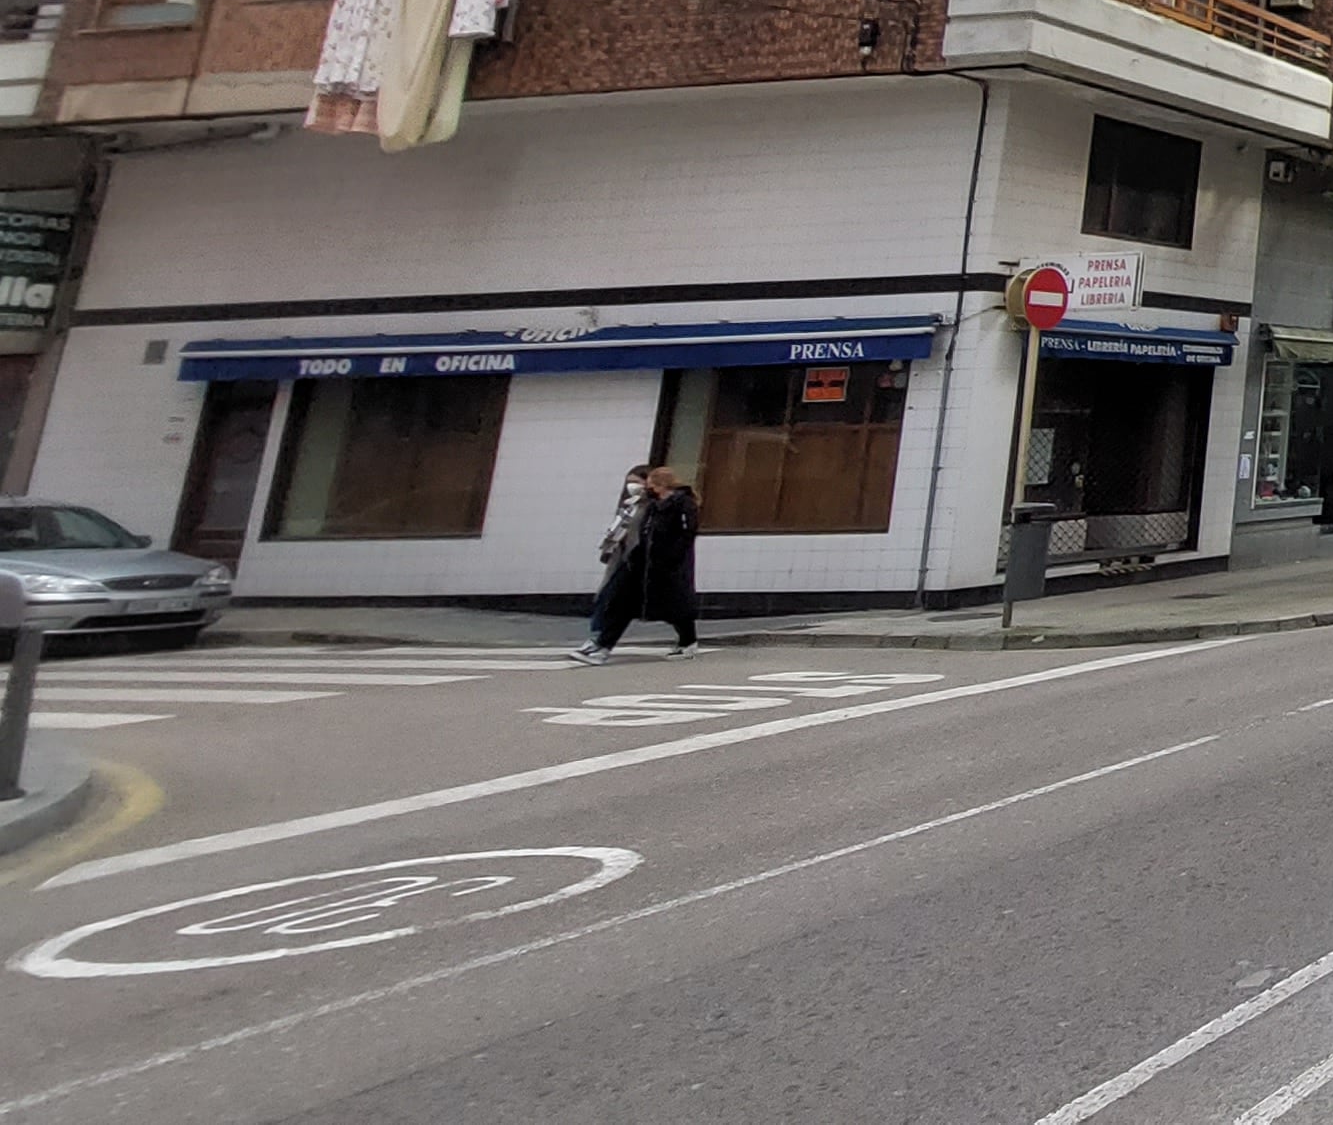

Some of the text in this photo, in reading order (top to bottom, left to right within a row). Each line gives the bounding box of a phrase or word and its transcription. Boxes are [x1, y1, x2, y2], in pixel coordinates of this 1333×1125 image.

[1087, 258, 1127, 272] PRENSA
[1078, 275, 1132, 288] PAPELERIA
[1081, 292, 1125, 306] LIBRERIA
[789, 341, 864, 360] PRENSA
[1040, 336, 1081, 351] PRENSA
[299, 354, 515, 375] TODO EN OFICINA
